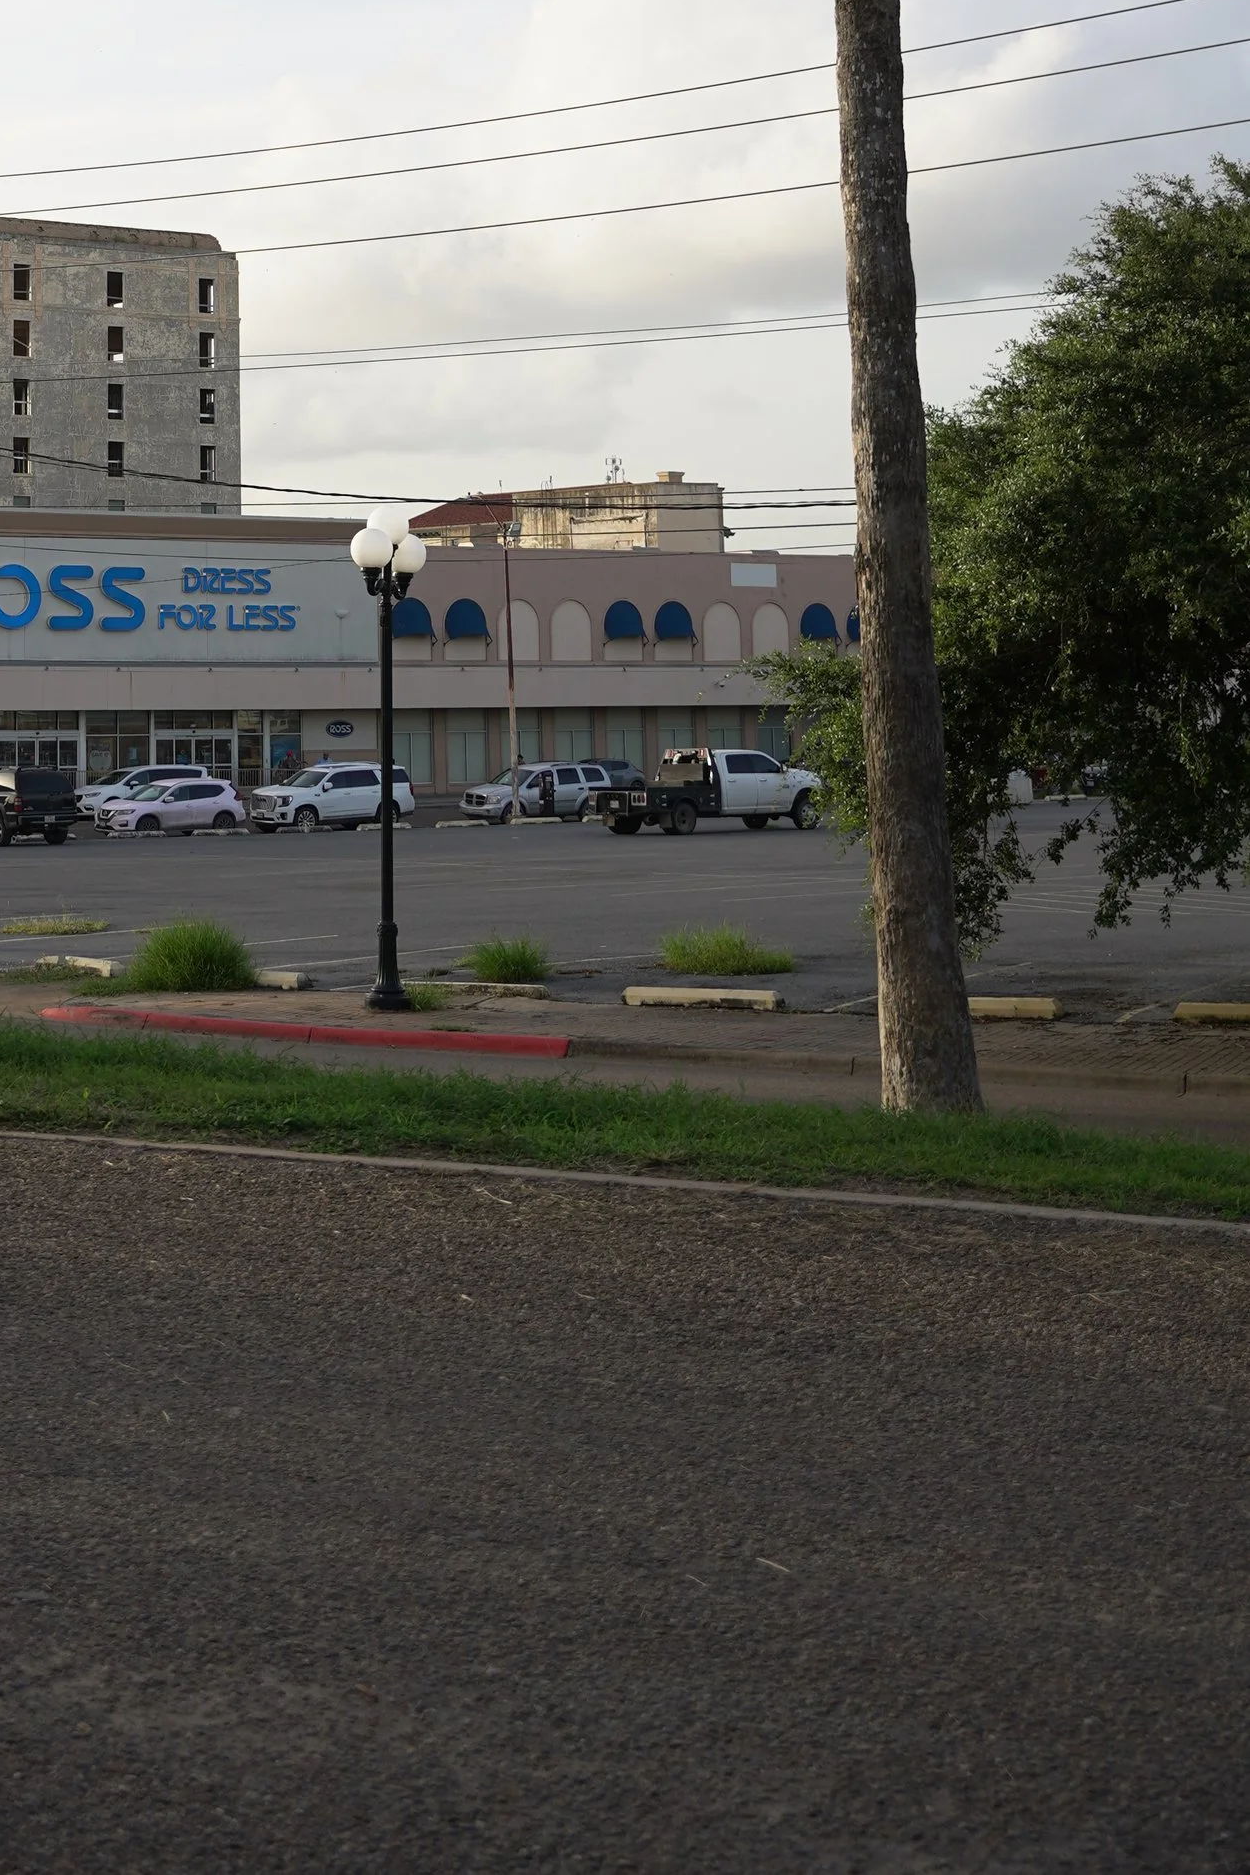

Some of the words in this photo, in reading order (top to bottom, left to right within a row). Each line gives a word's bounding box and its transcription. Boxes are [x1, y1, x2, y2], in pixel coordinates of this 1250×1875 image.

[181, 567, 272, 595] DRESS
[158, 604, 217, 630] FOR
[227, 605, 297, 631] LESS
[330, 724, 352, 734] ROSS
